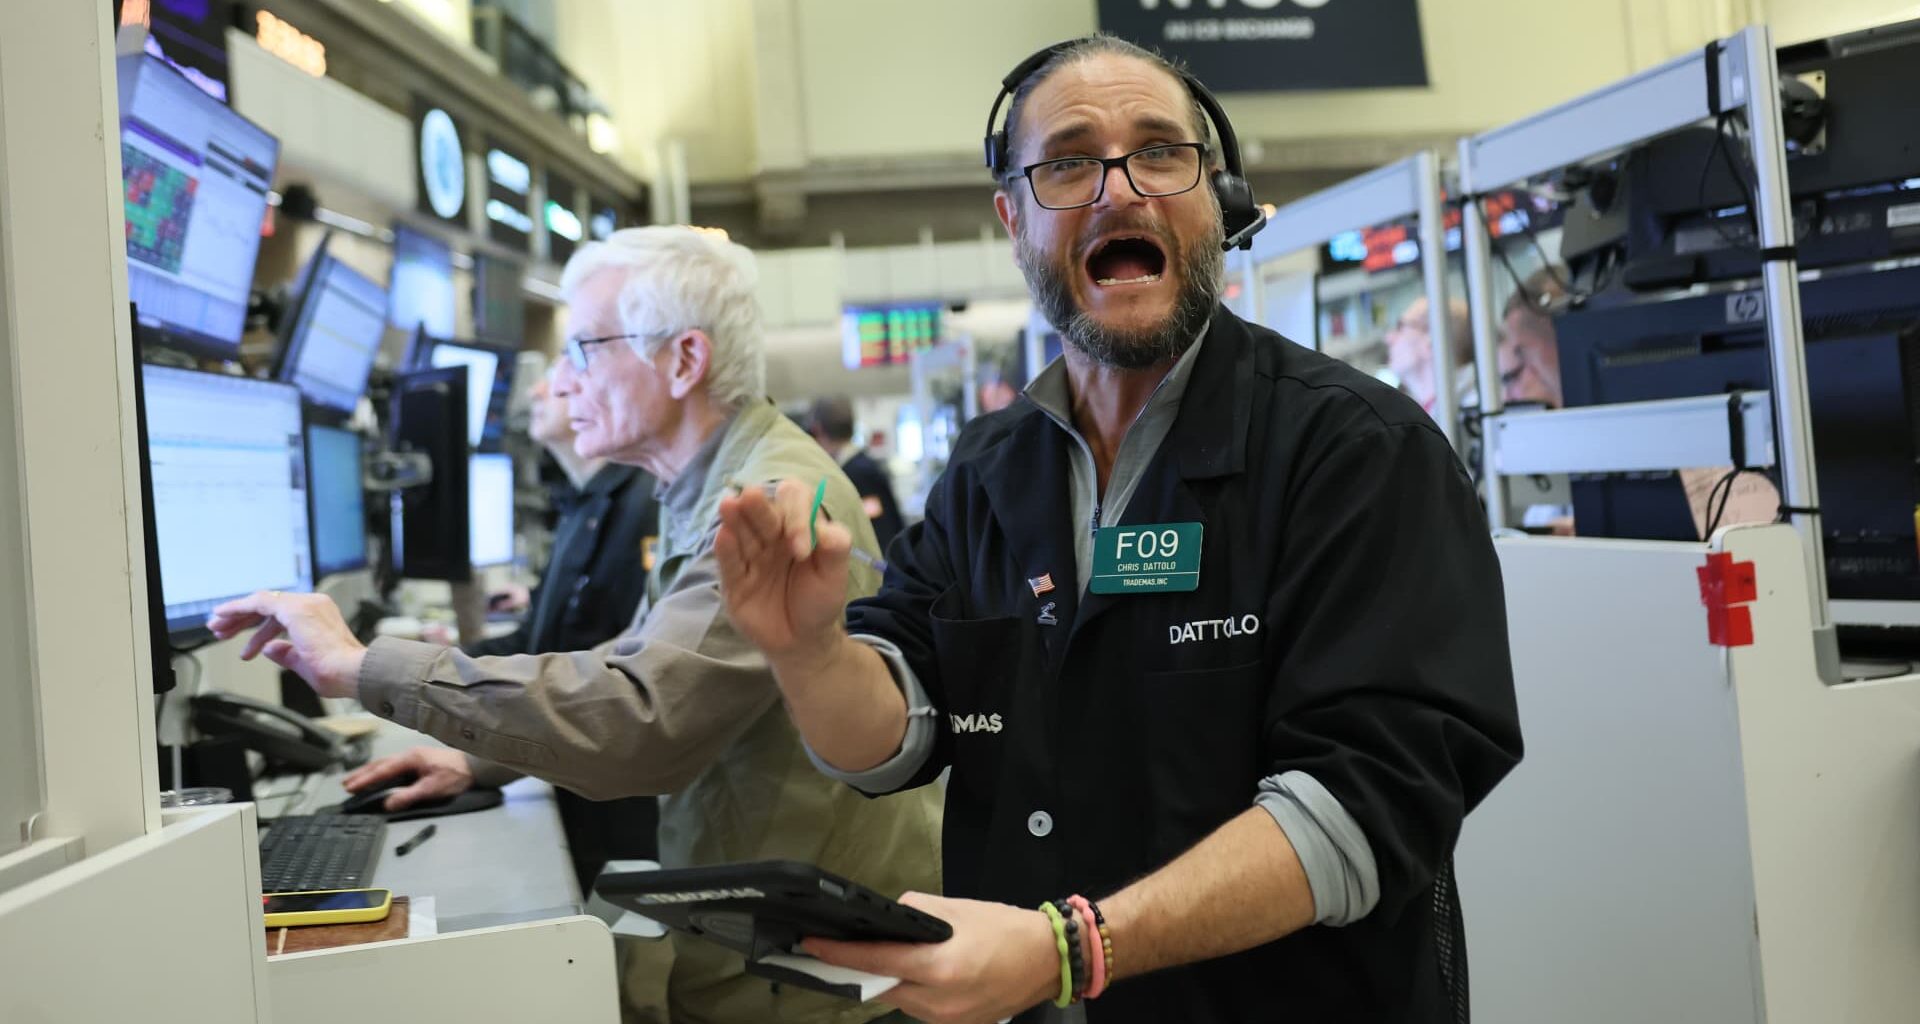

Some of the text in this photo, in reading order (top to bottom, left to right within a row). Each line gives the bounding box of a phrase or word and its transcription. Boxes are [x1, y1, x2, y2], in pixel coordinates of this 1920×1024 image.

[1116, 529, 1179, 559] F09
[1117, 561, 1176, 572] CHRIS DATTOLO
[1169, 614, 1259, 645] DATTOLO
